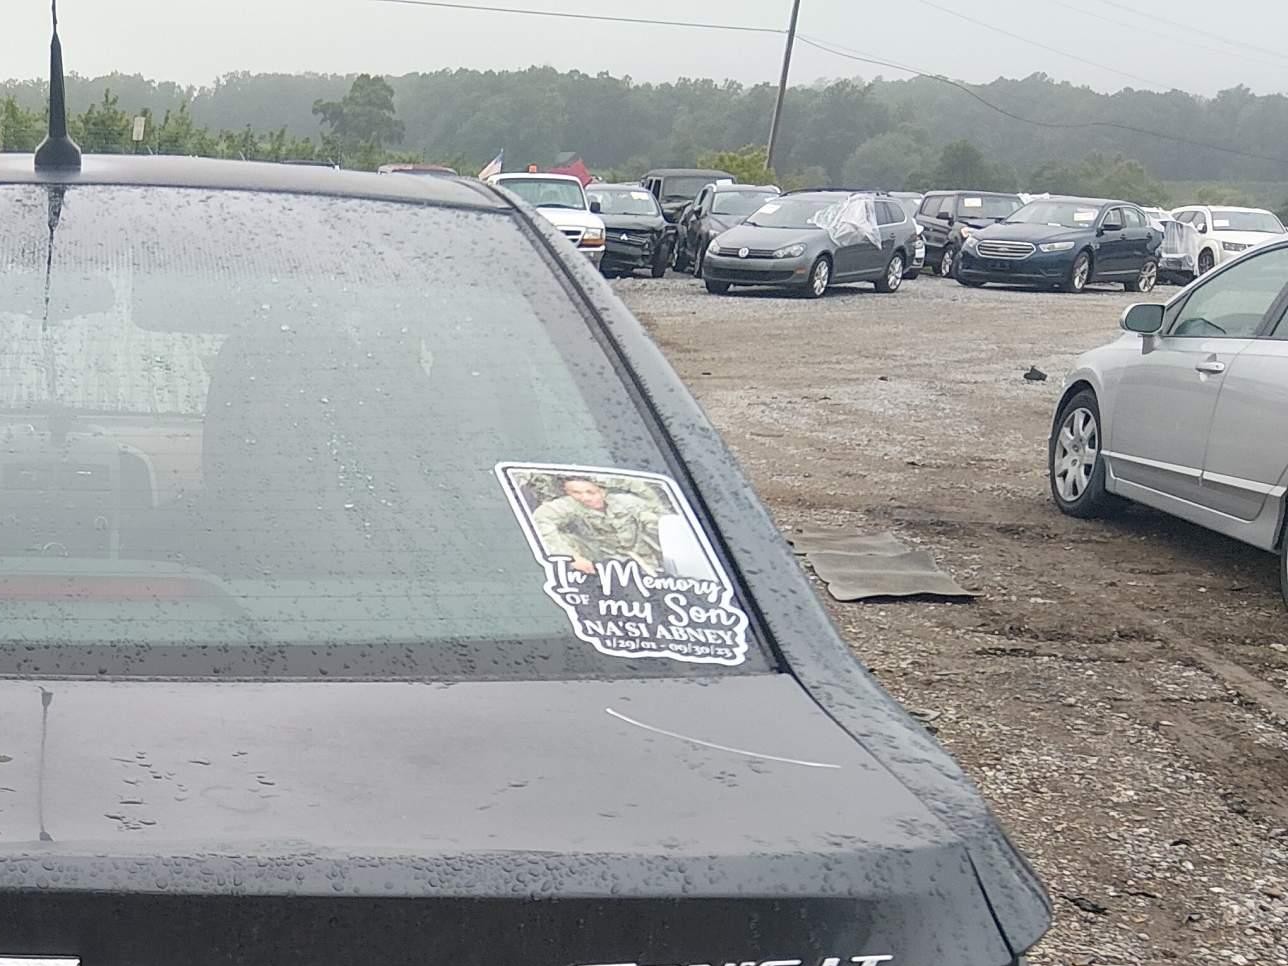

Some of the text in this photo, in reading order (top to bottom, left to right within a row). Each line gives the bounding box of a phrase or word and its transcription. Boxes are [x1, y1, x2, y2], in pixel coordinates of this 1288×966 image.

[547, 556, 721, 602] In Memory
[599, 599, 653, 624] my
[664, 593, 736, 627] Son
[656, 624, 733, 645] ABNEY
